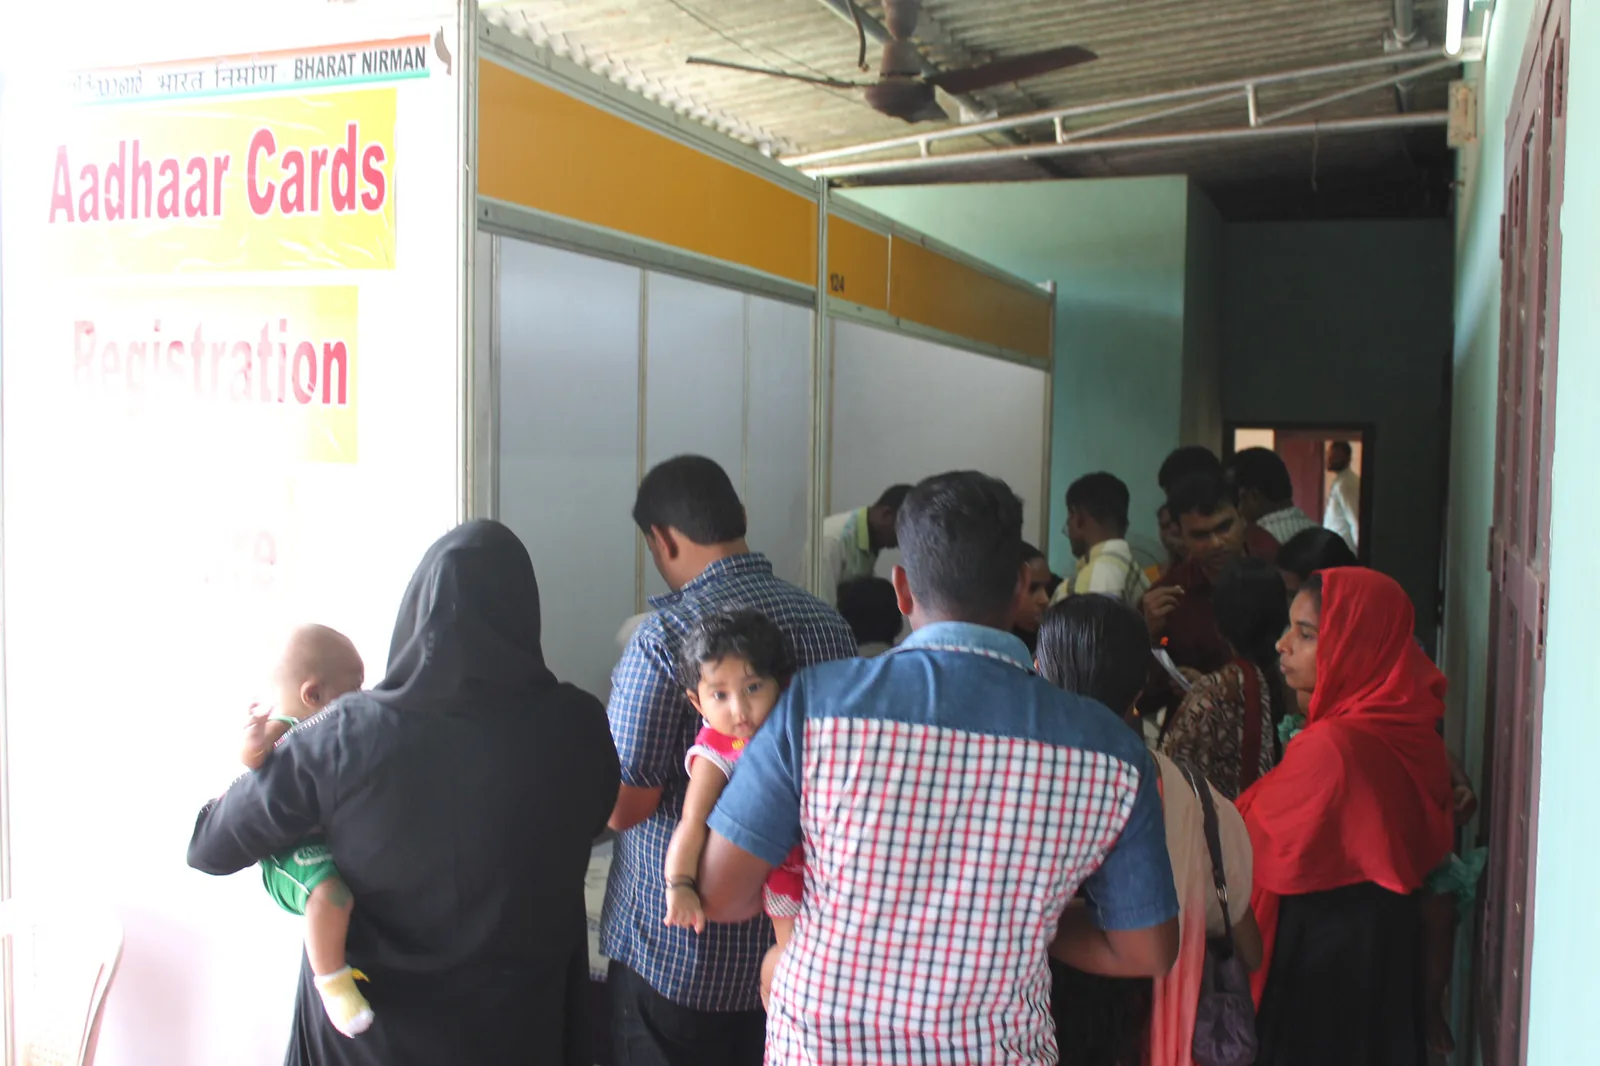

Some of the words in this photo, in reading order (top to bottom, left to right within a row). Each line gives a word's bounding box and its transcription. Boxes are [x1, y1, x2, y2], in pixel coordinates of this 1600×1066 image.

[157, 69, 205, 92] भारत
[214, 56, 277, 87] निर्माण
[295, 53, 356, 81] BHARAT
[362, 46, 426, 74] NIRMAN
[49, 140, 230, 223] Aadhaar
[247, 124, 386, 215] Cards
[830, 273, 845, 293] 124
[73, 319, 348, 411] Registration
